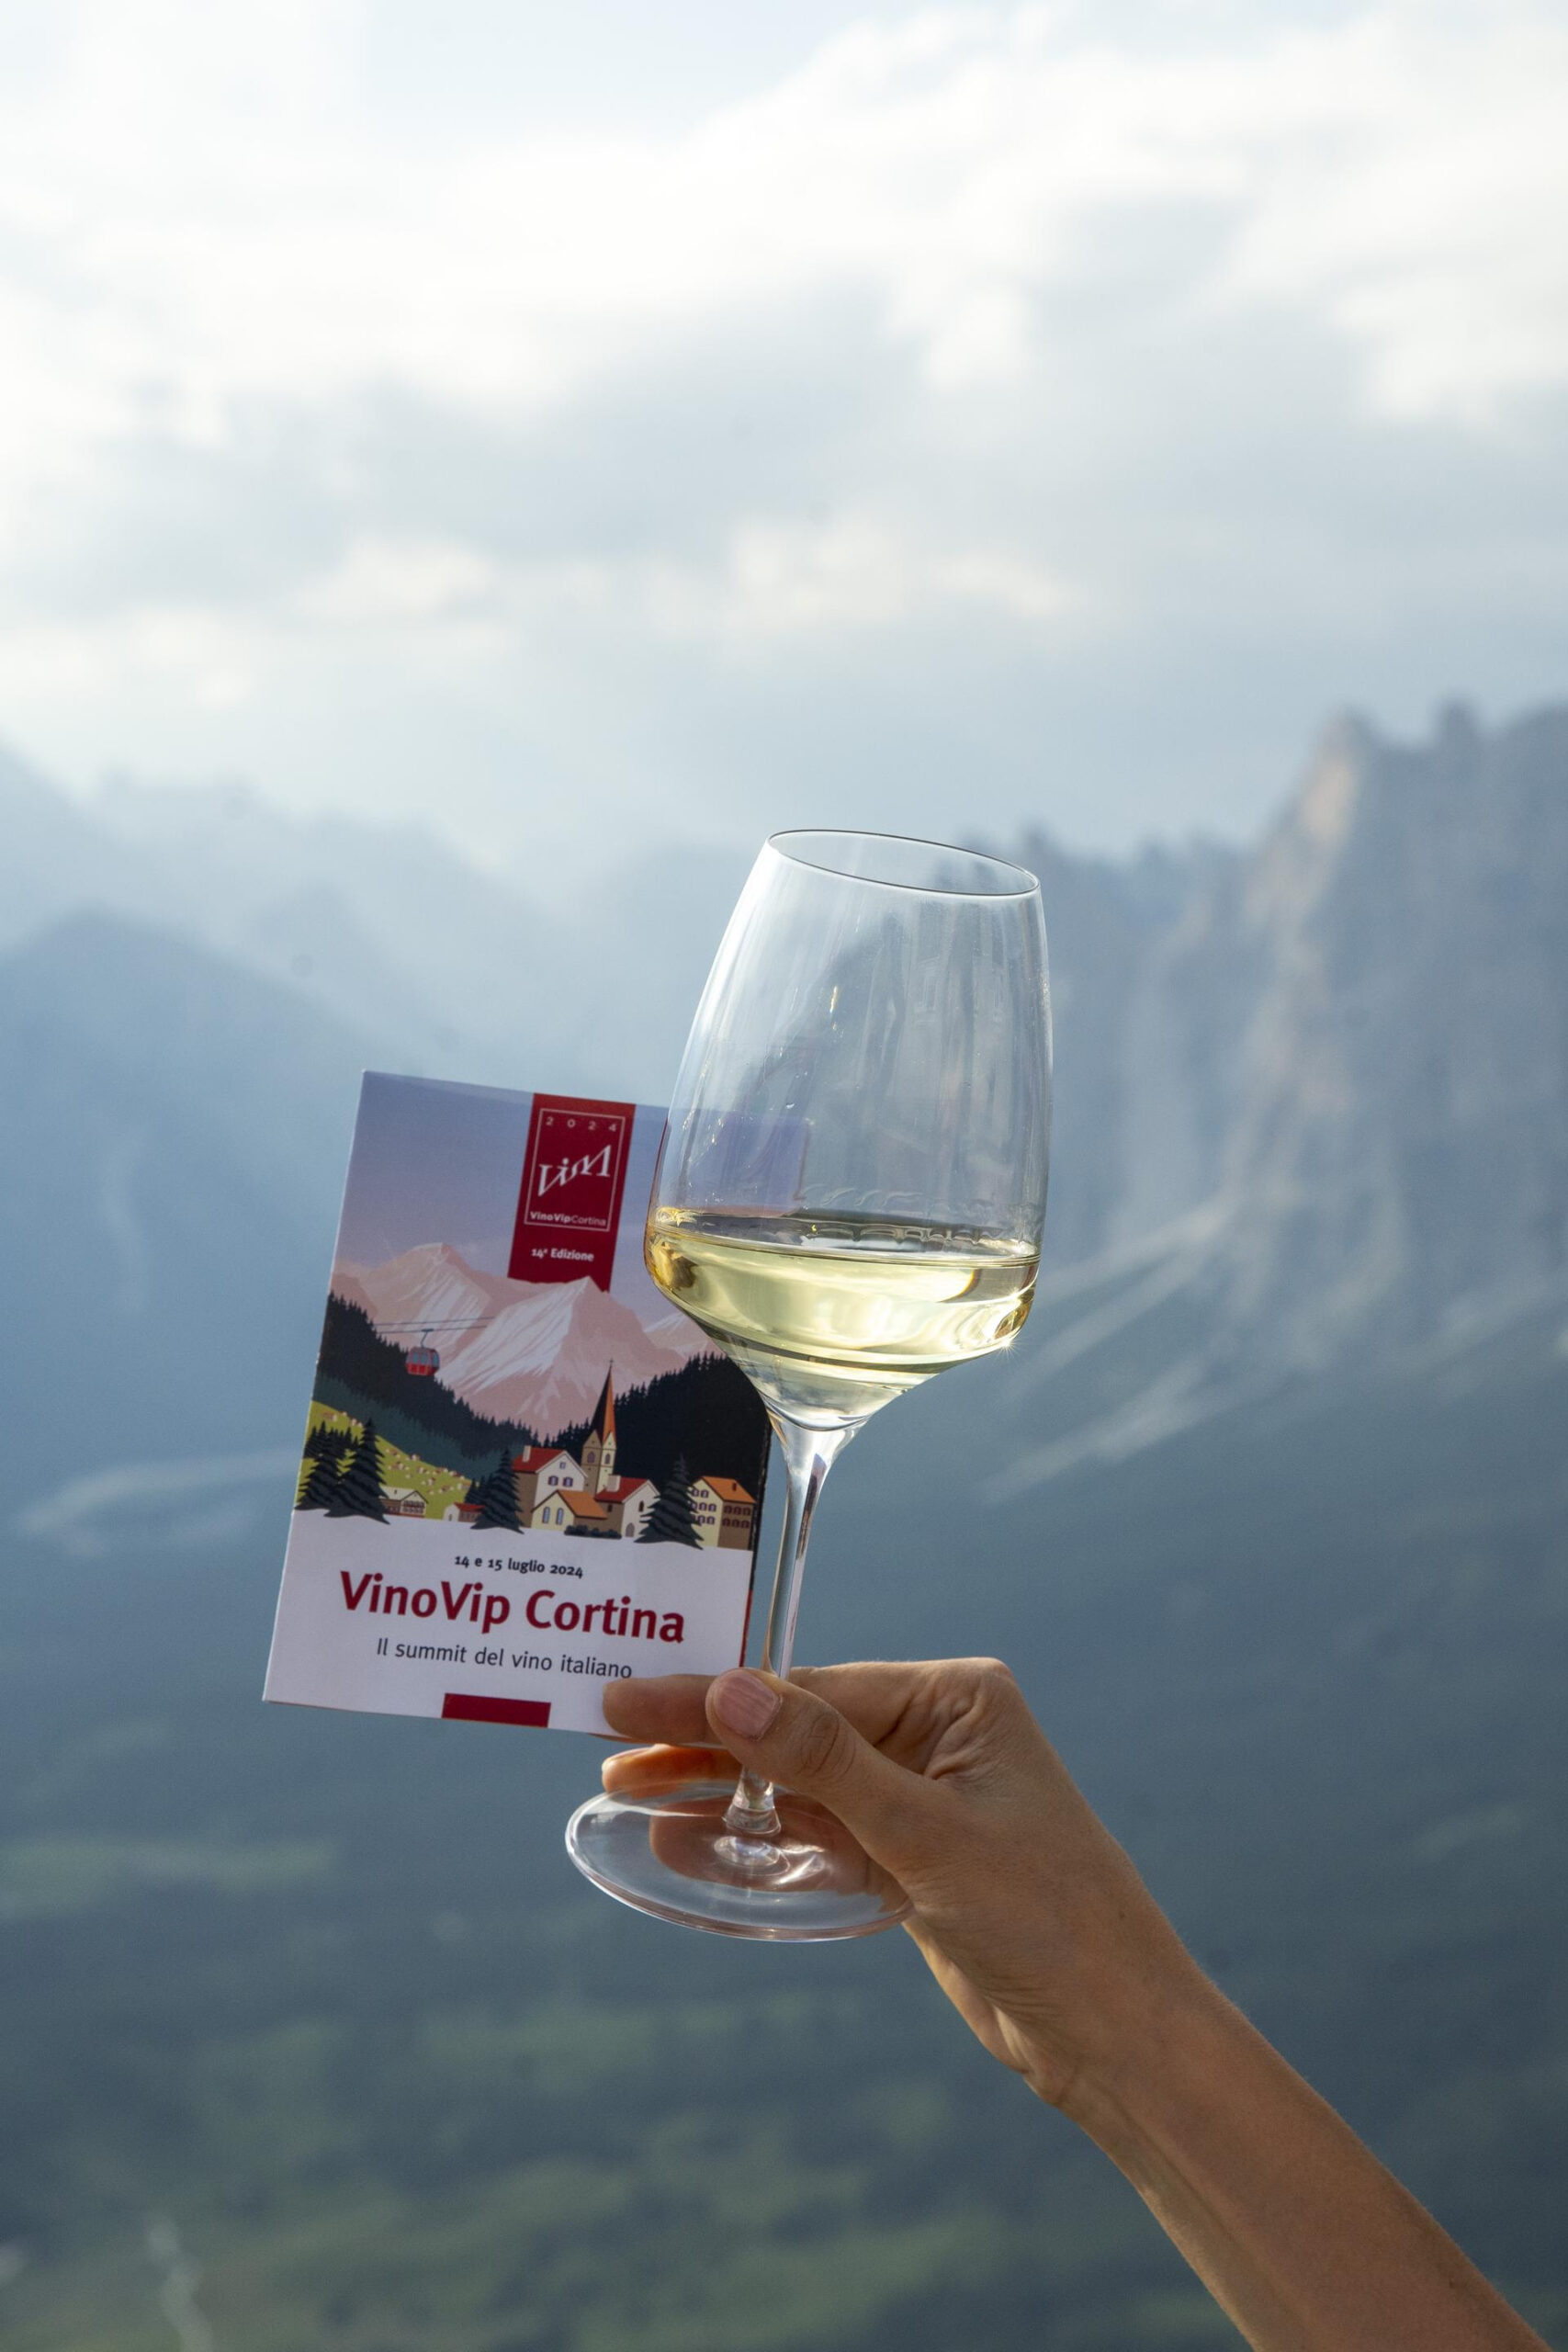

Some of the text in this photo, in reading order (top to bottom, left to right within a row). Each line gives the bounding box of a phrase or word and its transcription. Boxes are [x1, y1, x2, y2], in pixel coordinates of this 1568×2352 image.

[530, 1211, 606, 1227] VinoVipCortina
[550, 1248, 594, 1261] Edizione
[455, 1555, 584, 1580] 14 e 15 luglio 2024
[340, 1570, 685, 1644] VinoVip Cortina
[377, 1637, 633, 1679] Il summit del vino italiano
